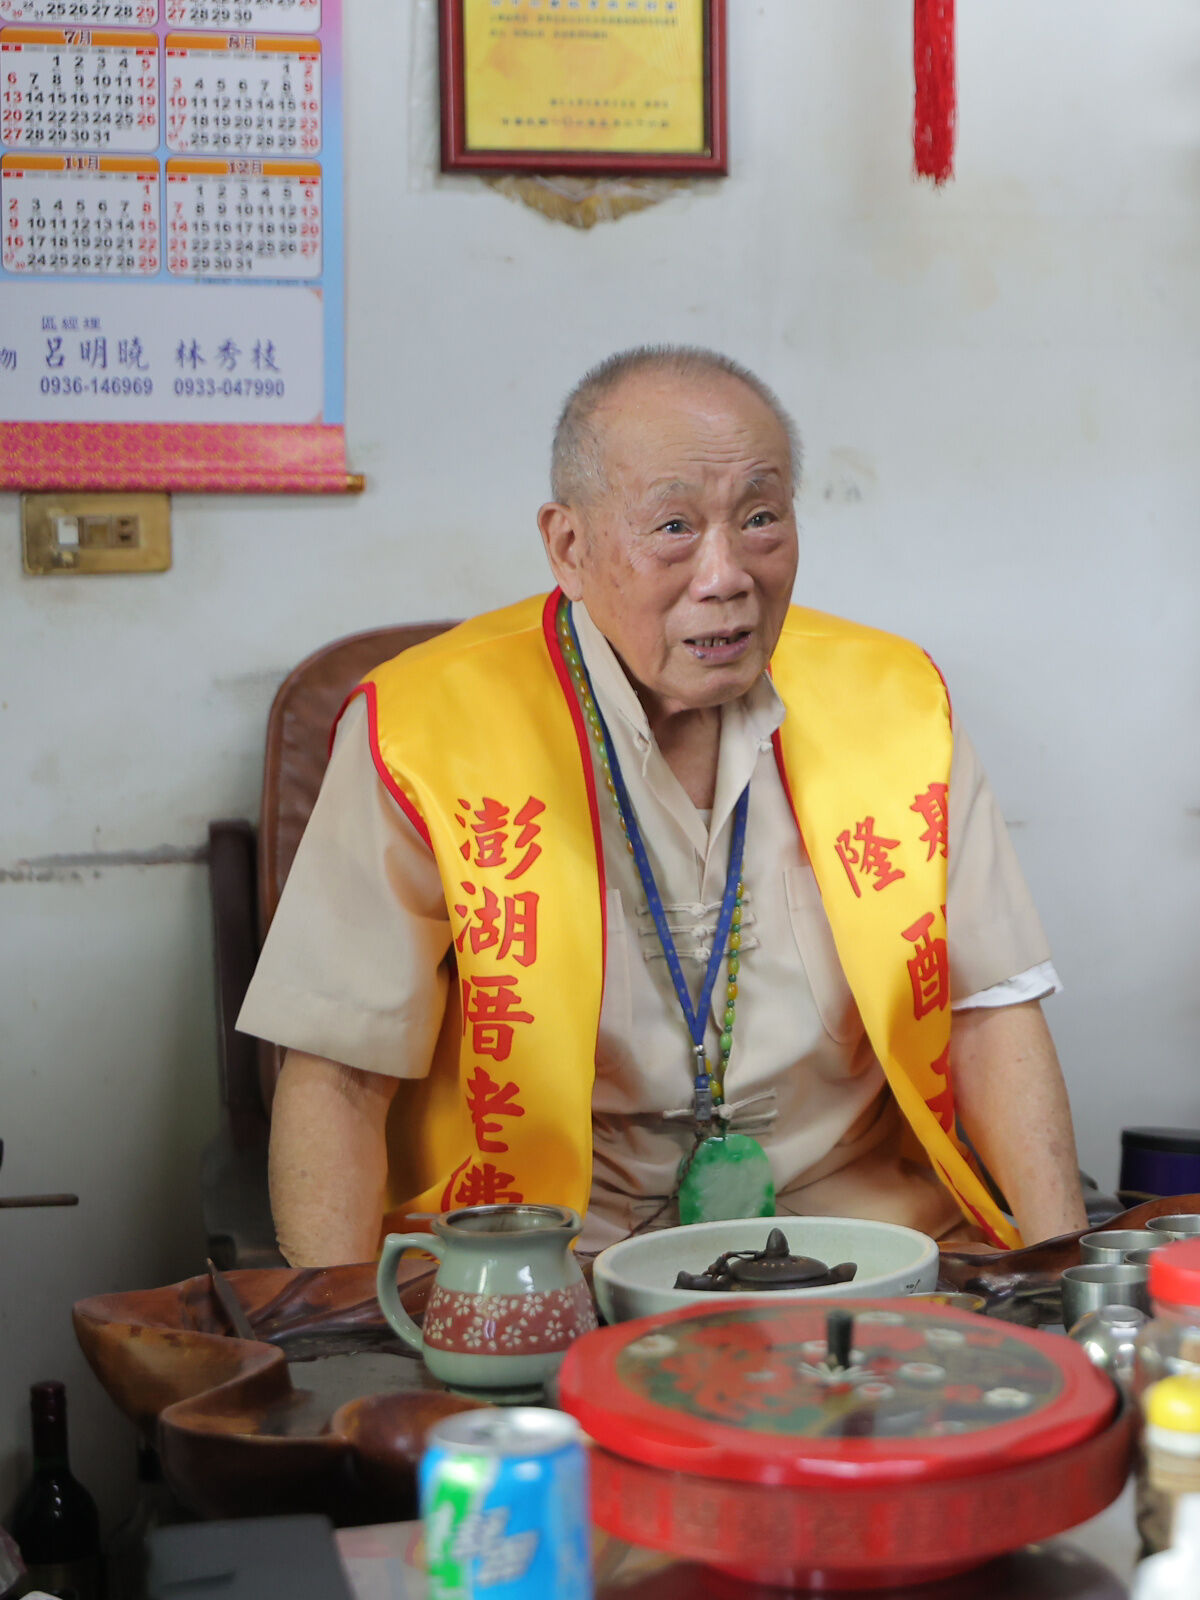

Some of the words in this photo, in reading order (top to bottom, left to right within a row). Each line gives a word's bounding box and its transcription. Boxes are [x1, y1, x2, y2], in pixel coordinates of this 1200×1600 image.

[47, 4, 65, 15] 25
[69, 4, 88, 15] 26
[92, 5, 111, 16] 27
[114, 5, 132, 17] 28
[136, 6, 155, 18] 29
[168, 8, 186, 19] 27
[190, 9, 208, 20] 28
[212, 9, 230, 20] 29
[234, 10, 252, 21] 30
[54, 56, 60, 67] 1
[75, 56, 83, 68] 2
[98, 57, 106, 68] 3
[119, 58, 128, 69] 4
[142, 59, 150, 70] 5
[283, 63, 290, 73] 1
[305, 63, 313, 74] 2
[8, 72, 16, 84] 6
[30, 73, 39, 84] 7
[53, 74, 61, 85] 8
[75, 75, 83, 86] 9
[93, 76, 111, 87] 10
[115, 76, 133, 88] 11
[138, 77, 156, 88] 12
[174, 78, 182, 88] 3
[195, 78, 203, 89] 4
[217, 79, 225, 90] 5
[239, 80, 247, 90] 6
[261, 80, 269, 91] 7
[282, 81, 291, 92] 8
[305, 81, 313, 92] 9
[3, 91, 22, 103] 13
[26, 92, 44, 103] 14
[49, 93, 66, 104] 15
[71, 94, 89, 105] 16
[93, 94, 111, 106] 17
[115, 95, 133, 106] 18
[138, 96, 156, 107] 19
[169, 97, 186, 108] 10
[192, 97, 208, 108] 11
[213, 98, 230, 109] 12
[235, 99, 252, 109] 13
[257, 99, 274, 110] 14
[279, 100, 296, 111] 15
[301, 101, 318, 111] 16
[3, 110, 22, 121] 20
[26, 110, 44, 122] 21
[49, 111, 66, 122] 22
[71, 112, 89, 123] 23
[93, 113, 111, 124] 24
[115, 114, 133, 125] 25
[138, 114, 156, 126] 26
[169, 115, 186, 126] 17
[192, 116, 208, 126] 18
[213, 116, 230, 127] 19
[235, 117, 252, 128] 20
[257, 118, 274, 128] 21
[279, 118, 296, 129] 22
[301, 119, 318, 130] 23
[3, 128, 22, 139] 27
[26, 129, 44, 140] 28
[49, 130, 66, 141] 29
[71, 131, 89, 142] 30
[93, 131, 111, 143] 31
[192, 134, 208, 144] 25
[213, 134, 230, 145] 26
[235, 135, 252, 146] 27
[257, 136, 274, 146] 28
[279, 136, 296, 147] 29
[301, 137, 318, 148] 30
[144, 185, 150, 196] 1
[197, 185, 204, 196] 1
[218, 185, 226, 196] 2
[241, 186, 248, 197] 3
[262, 187, 270, 197] 4
[283, 187, 291, 198] 5
[305, 188, 313, 198] 6
[9, 199, 18, 210] 2
[32, 199, 40, 210] 3
[54, 200, 62, 211] 4
[76, 200, 85, 211] 5
[99, 201, 107, 212] 6
[122, 201, 129, 212] 7
[143, 202, 151, 213] 8
[175, 202, 183, 213] 7
[196, 203, 204, 214] 8
[218, 204, 226, 214] 9
[236, 204, 253, 215] 10
[258, 205, 274, 215] 11
[280, 205, 296, 216] 12
[301, 206, 319, 216] 13
[9, 218, 18, 229] 9
[28, 218, 46, 229] 10
[51, 219, 68, 230] 11
[72, 219, 90, 230] 12
[95, 220, 112, 231] 13
[117, 220, 134, 231] 14
[139, 221, 157, 232] 15
[170, 222, 187, 232] 14
[192, 222, 209, 233] 15
[214, 223, 231, 233] 16
[236, 223, 253, 234] 17
[258, 224, 274, 234] 18
[280, 224, 296, 235] 19
[301, 225, 319, 235] 20
[6, 237, 24, 247] 16
[28, 237, 46, 248] 17
[51, 238, 68, 249] 18
[72, 238, 90, 249] 19
[95, 239, 112, 250] 20
[117, 239, 134, 250] 21
[139, 240, 157, 251] 22
[170, 240, 187, 250] 21
[192, 240, 209, 251] 22
[214, 241, 231, 251] 23
[236, 241, 253, 252] 24
[258, 242, 274, 253] 25
[280, 242, 296, 253] 26
[301, 243, 319, 254] 27
[28, 255, 46, 266] 24
[51, 255, 68, 266] 25
[72, 256, 90, 267] 26
[95, 256, 112, 267] 27
[117, 257, 134, 268] 28
[139, 257, 157, 268] 29
[170, 257, 187, 268] 28
[192, 258, 209, 268] 29
[214, 258, 231, 269] 30
[236, 259, 253, 270] 31
[45, 336, 150, 371] 呂明曉
[175, 338, 281, 372] 林秀枝
[40, 376, 153, 395] 0936-146969
[174, 377, 285, 397] 0933-047990
